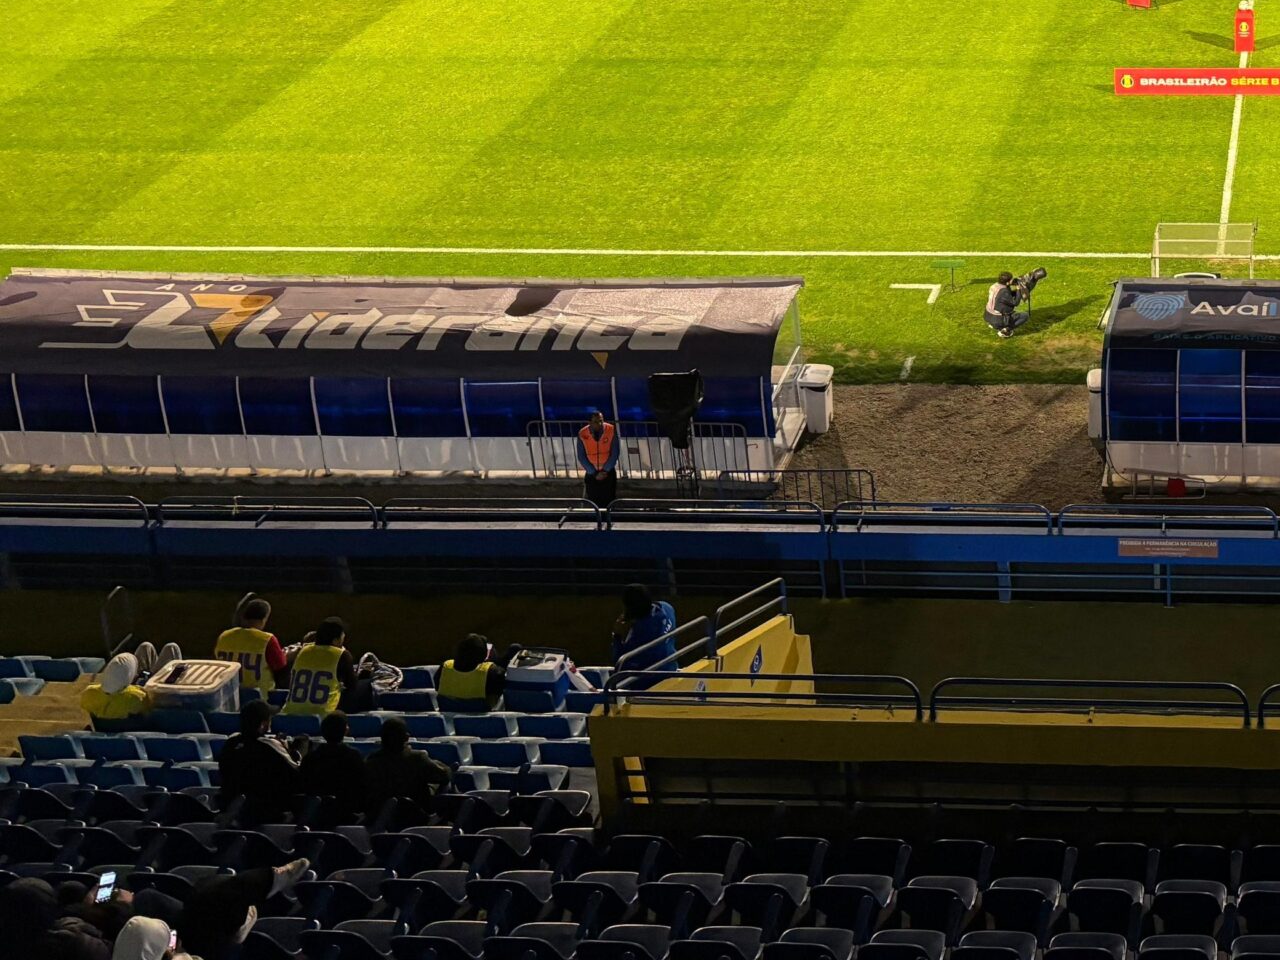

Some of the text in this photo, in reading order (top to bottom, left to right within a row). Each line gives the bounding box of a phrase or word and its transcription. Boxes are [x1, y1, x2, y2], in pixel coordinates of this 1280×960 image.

[1140, 75, 1227, 86] BRASILEIRÃO
[1231, 75, 1269, 86] SÉRIE
[1271, 77, 1280, 86] B
